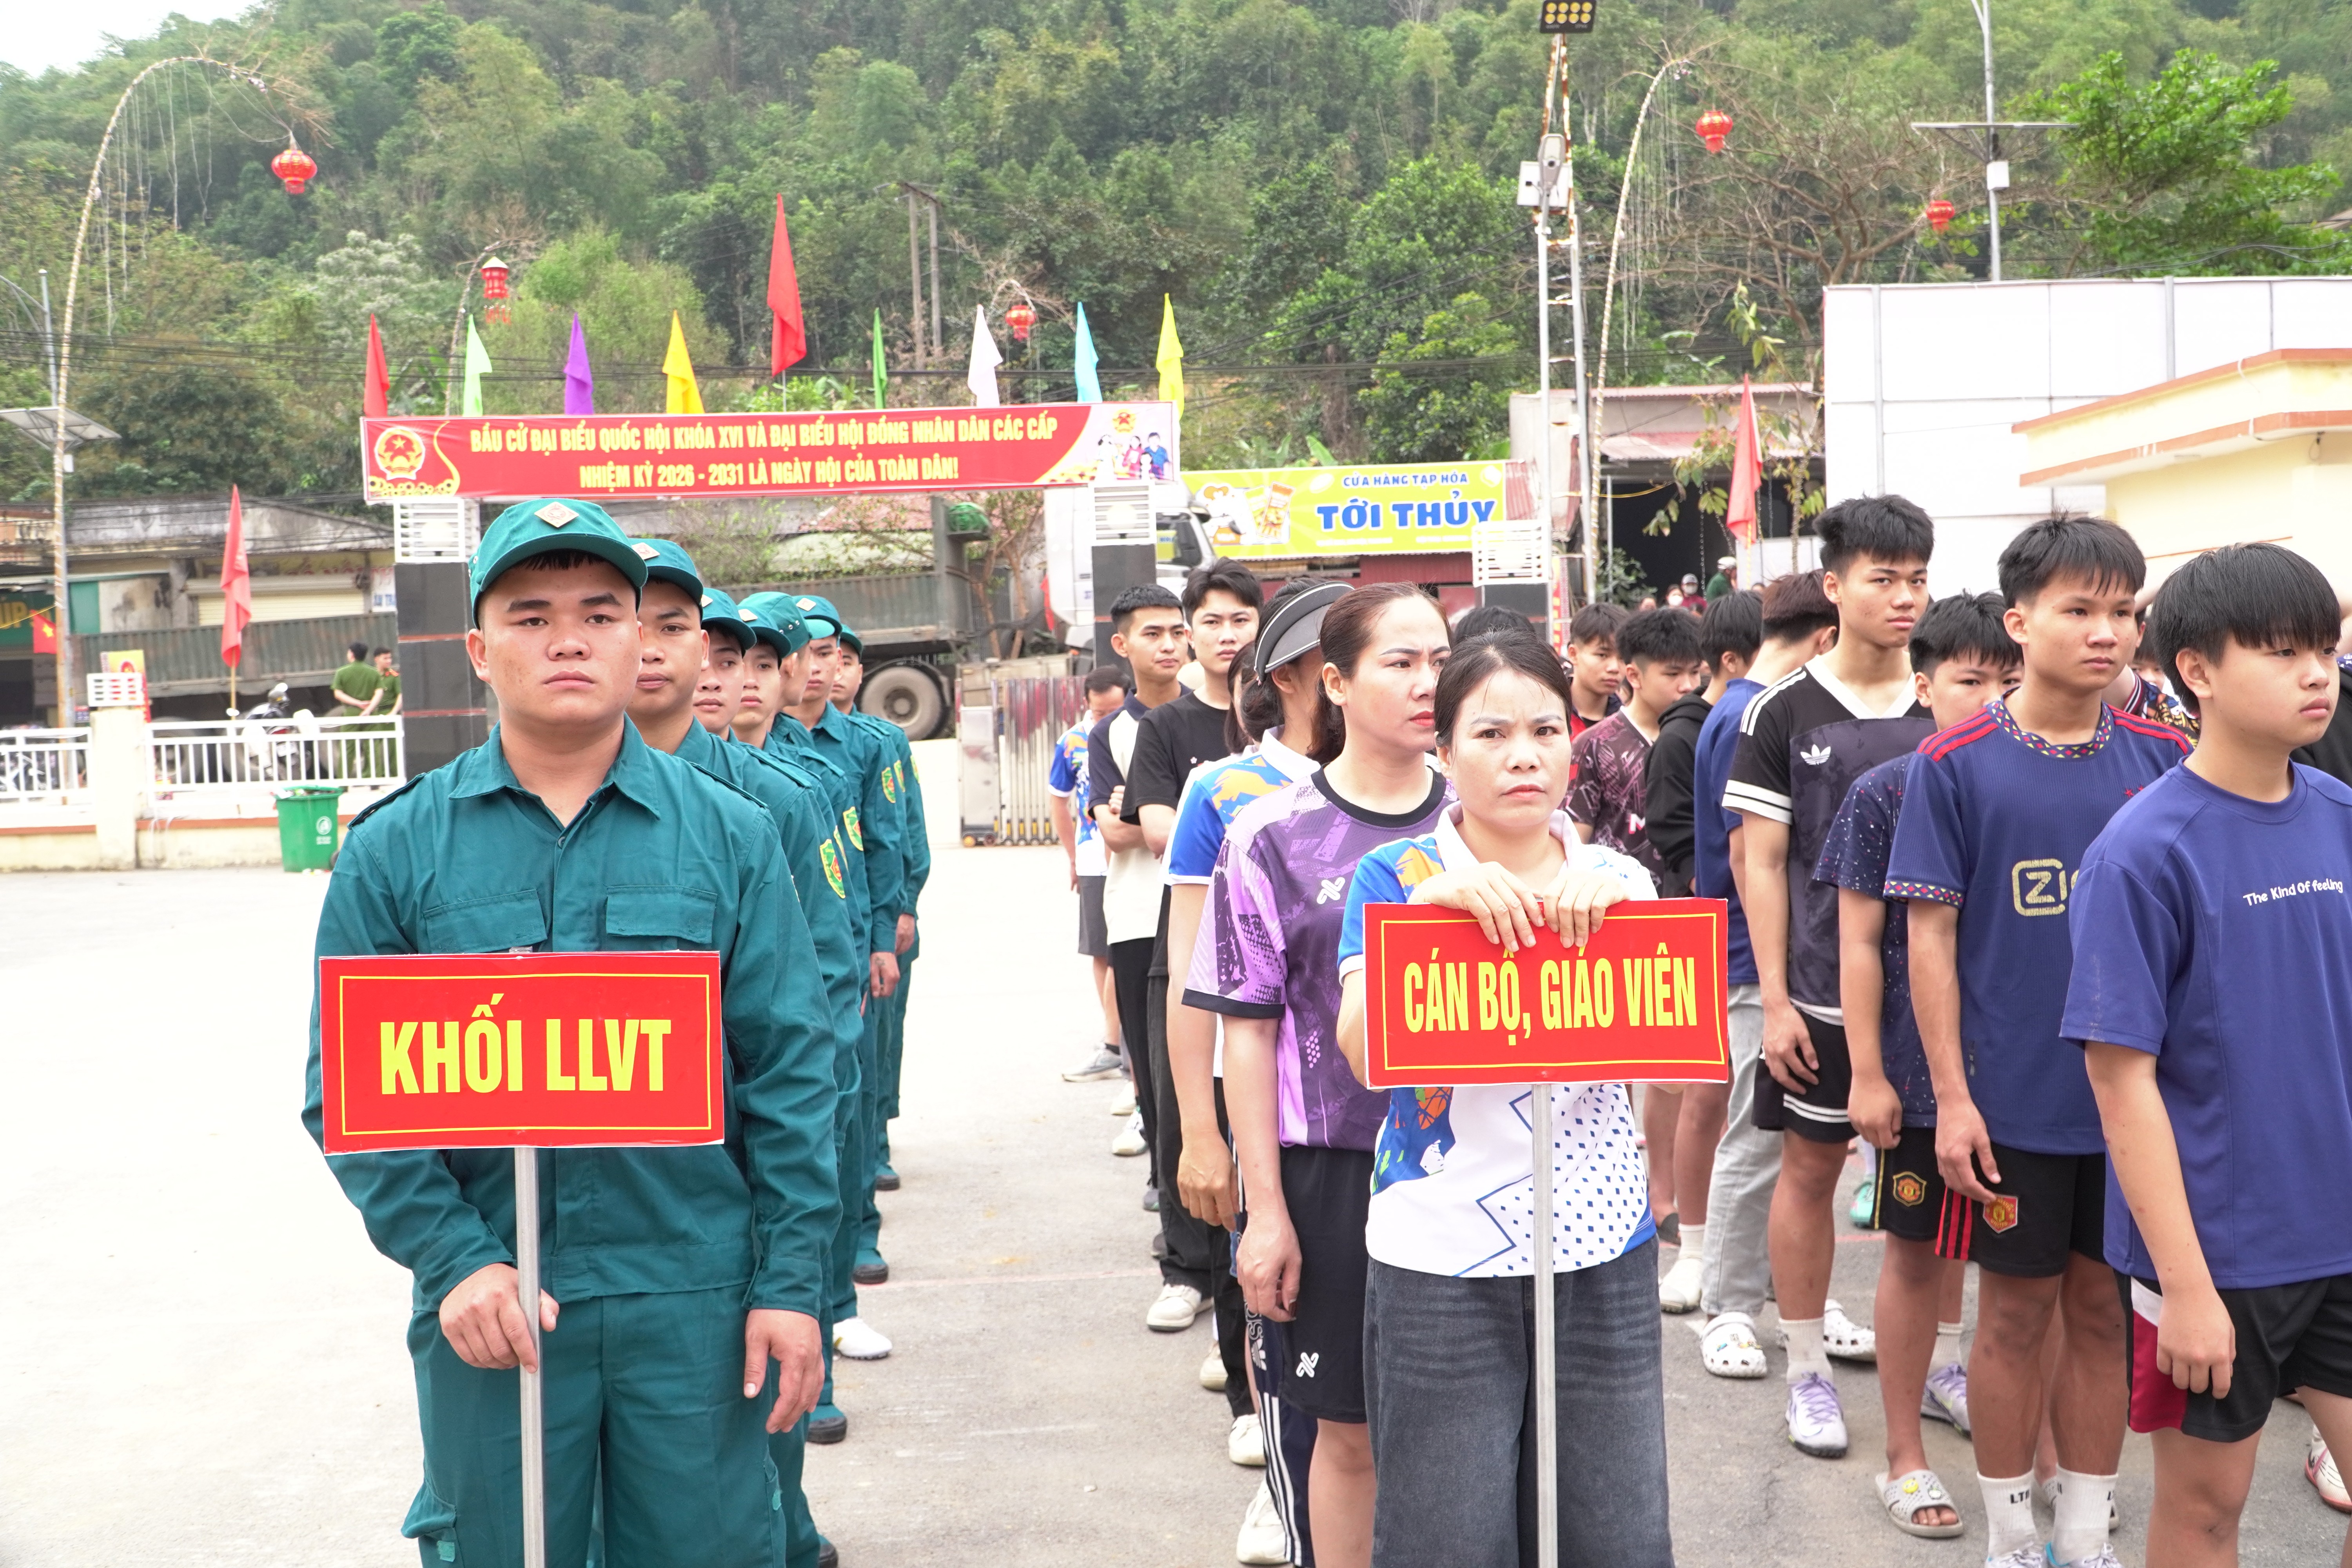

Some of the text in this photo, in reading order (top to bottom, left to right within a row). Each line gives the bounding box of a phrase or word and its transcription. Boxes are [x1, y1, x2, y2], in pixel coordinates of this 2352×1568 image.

[506, 421, 528, 452] CỬ
[530, 428, 557, 456] ĐẠI
[560, 419, 596, 451] BIỂU
[599, 420, 641, 453] QUỐC
[644, 423, 670, 454] HỘI
[674, 422, 715, 450] KHÓA
[718, 425, 744, 448] XVI
[746, 421, 768, 448] VÀ
[769, 424, 796, 452] ĐẠI
[799, 415, 835, 446] BIỂU
[838, 418, 864, 450] HỘI
[912, 416, 955, 443] NHÂN
[958, 415, 990, 442] DÂN
[993, 414, 1024, 441] CÁC
[1027, 410, 1058, 440] CẤP
[579, 461, 630, 493] NHIỆM
[633, 460, 653, 488] KỲ
[657, 464, 695, 487] 2026
[708, 463, 744, 486] 2031
[748, 457, 769, 485] LÀ
[771, 457, 812, 484] NGÀY
[815, 456, 841, 488] HỘI
[845, 452, 876, 482] CỦA
[878, 454, 918, 481] TOÀN
[921, 453, 959, 480] DÂN!
[1343, 472, 1468, 489] CỬA HÀNG TẠP HÓA
[1317, 498, 1381, 530] TỚI
[1392, 490, 1495, 527] THỦY
[2243, 878, 2343, 906] The Kind Of feeling
[1403, 942, 1698, 1046] CÁN BỘ, GIÁO VIÊN
[380, 993, 671, 1095] KHỐI LLVT
